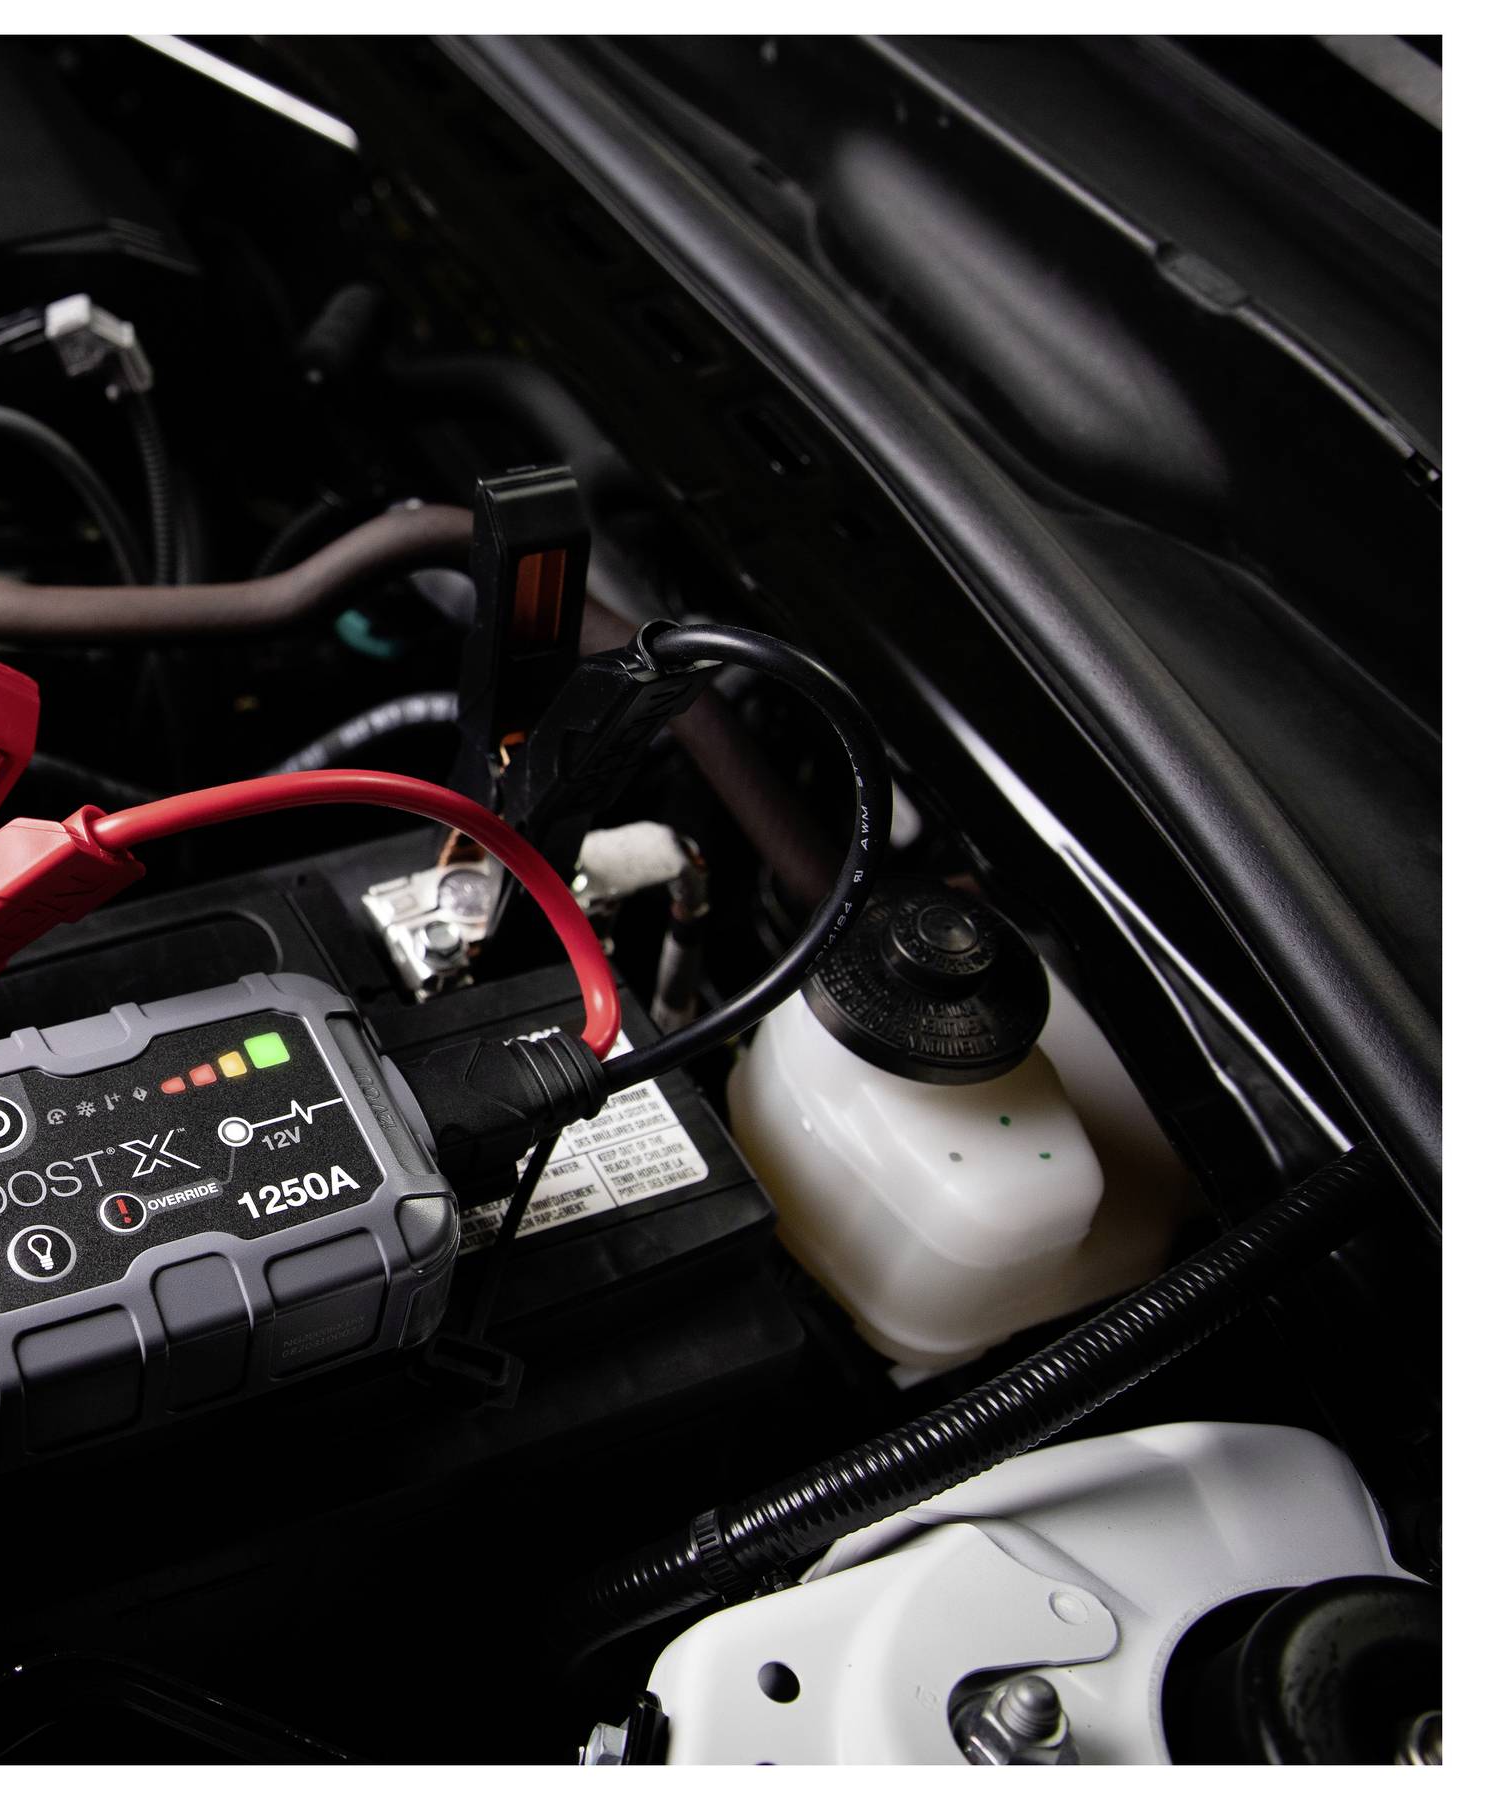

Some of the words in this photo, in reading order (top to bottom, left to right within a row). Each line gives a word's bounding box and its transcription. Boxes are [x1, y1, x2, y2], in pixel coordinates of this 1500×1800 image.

[261, 1126, 302, 1151] 12V
[147, 1182, 219, 1211] OVERRIDE
[237, 1165, 361, 1219] 1250A
